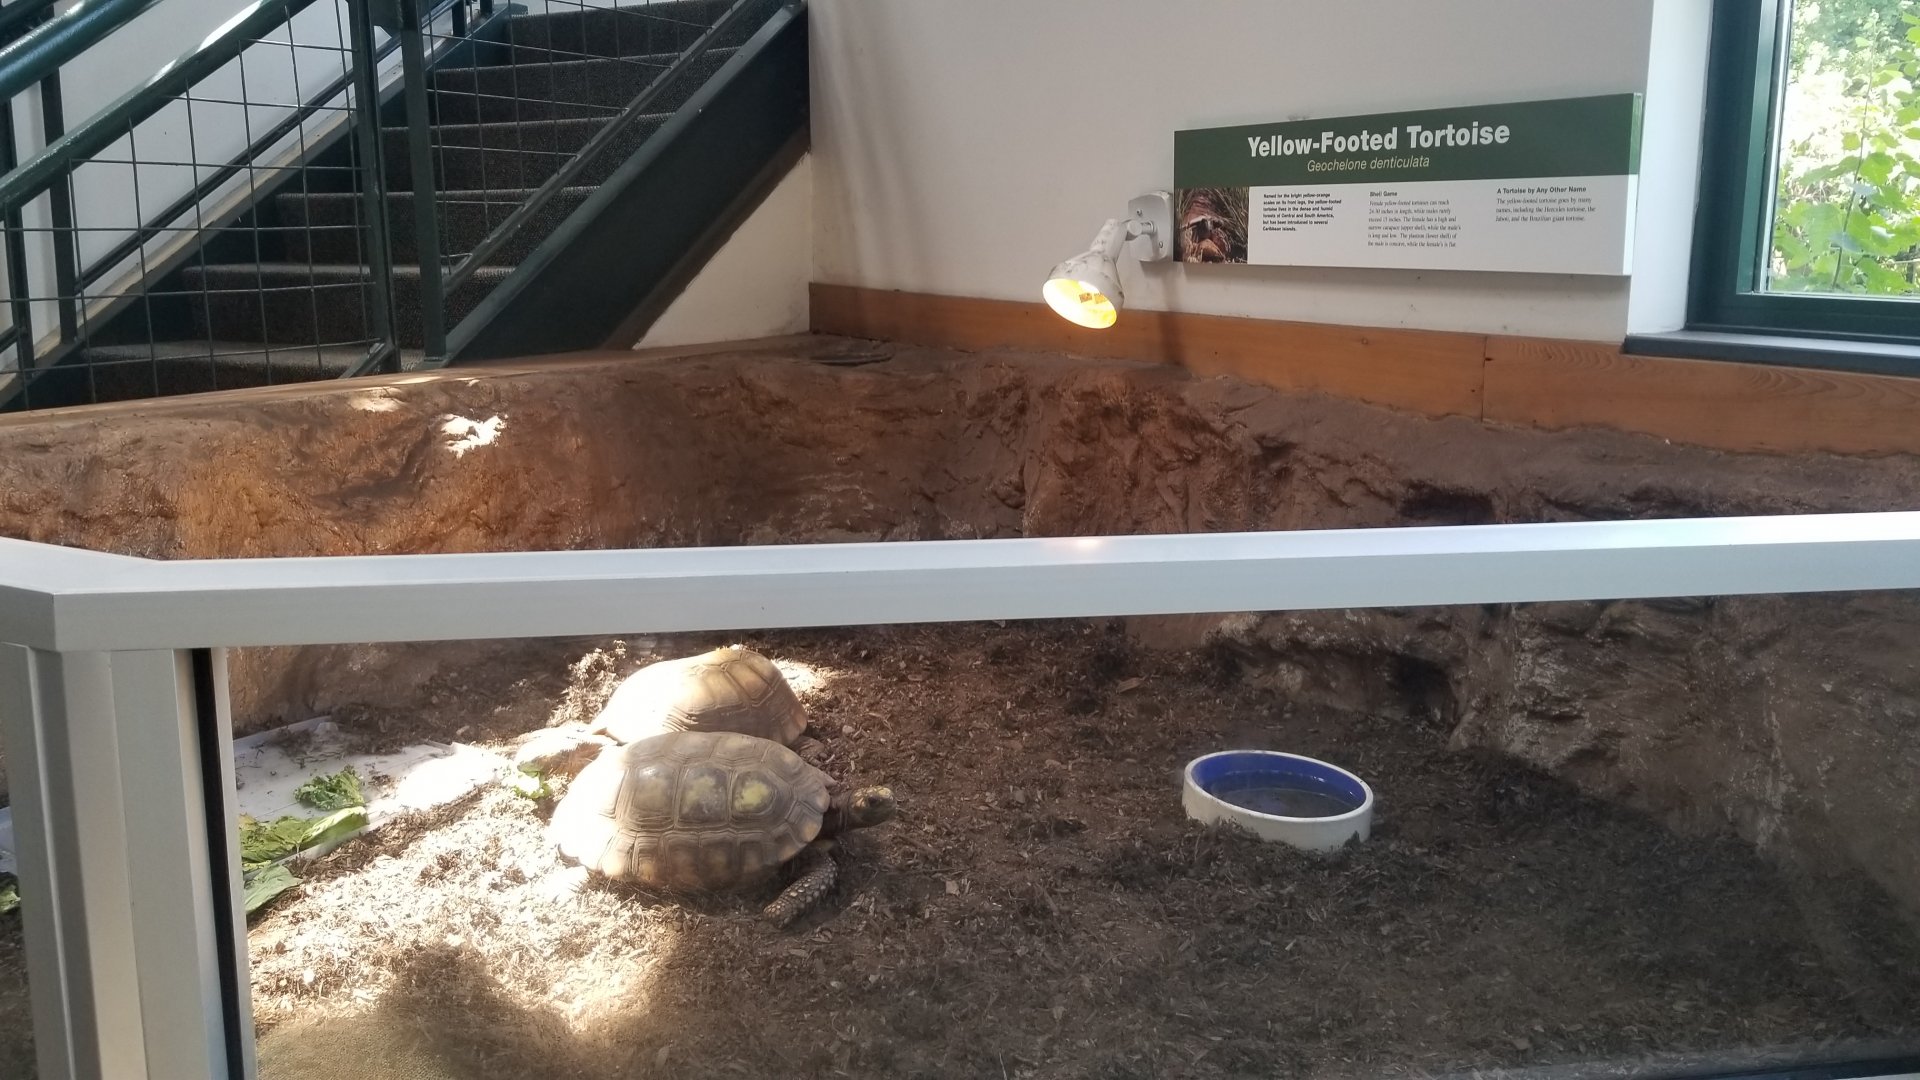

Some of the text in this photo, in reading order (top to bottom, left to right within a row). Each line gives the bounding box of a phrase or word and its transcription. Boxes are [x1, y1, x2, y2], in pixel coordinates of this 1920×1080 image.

[1248, 122, 1510, 158] Yellow-Footed Tortoise
[1307, 155, 1430, 172] Geochelone denticulata
[1528, 187, 1535, 195] by
